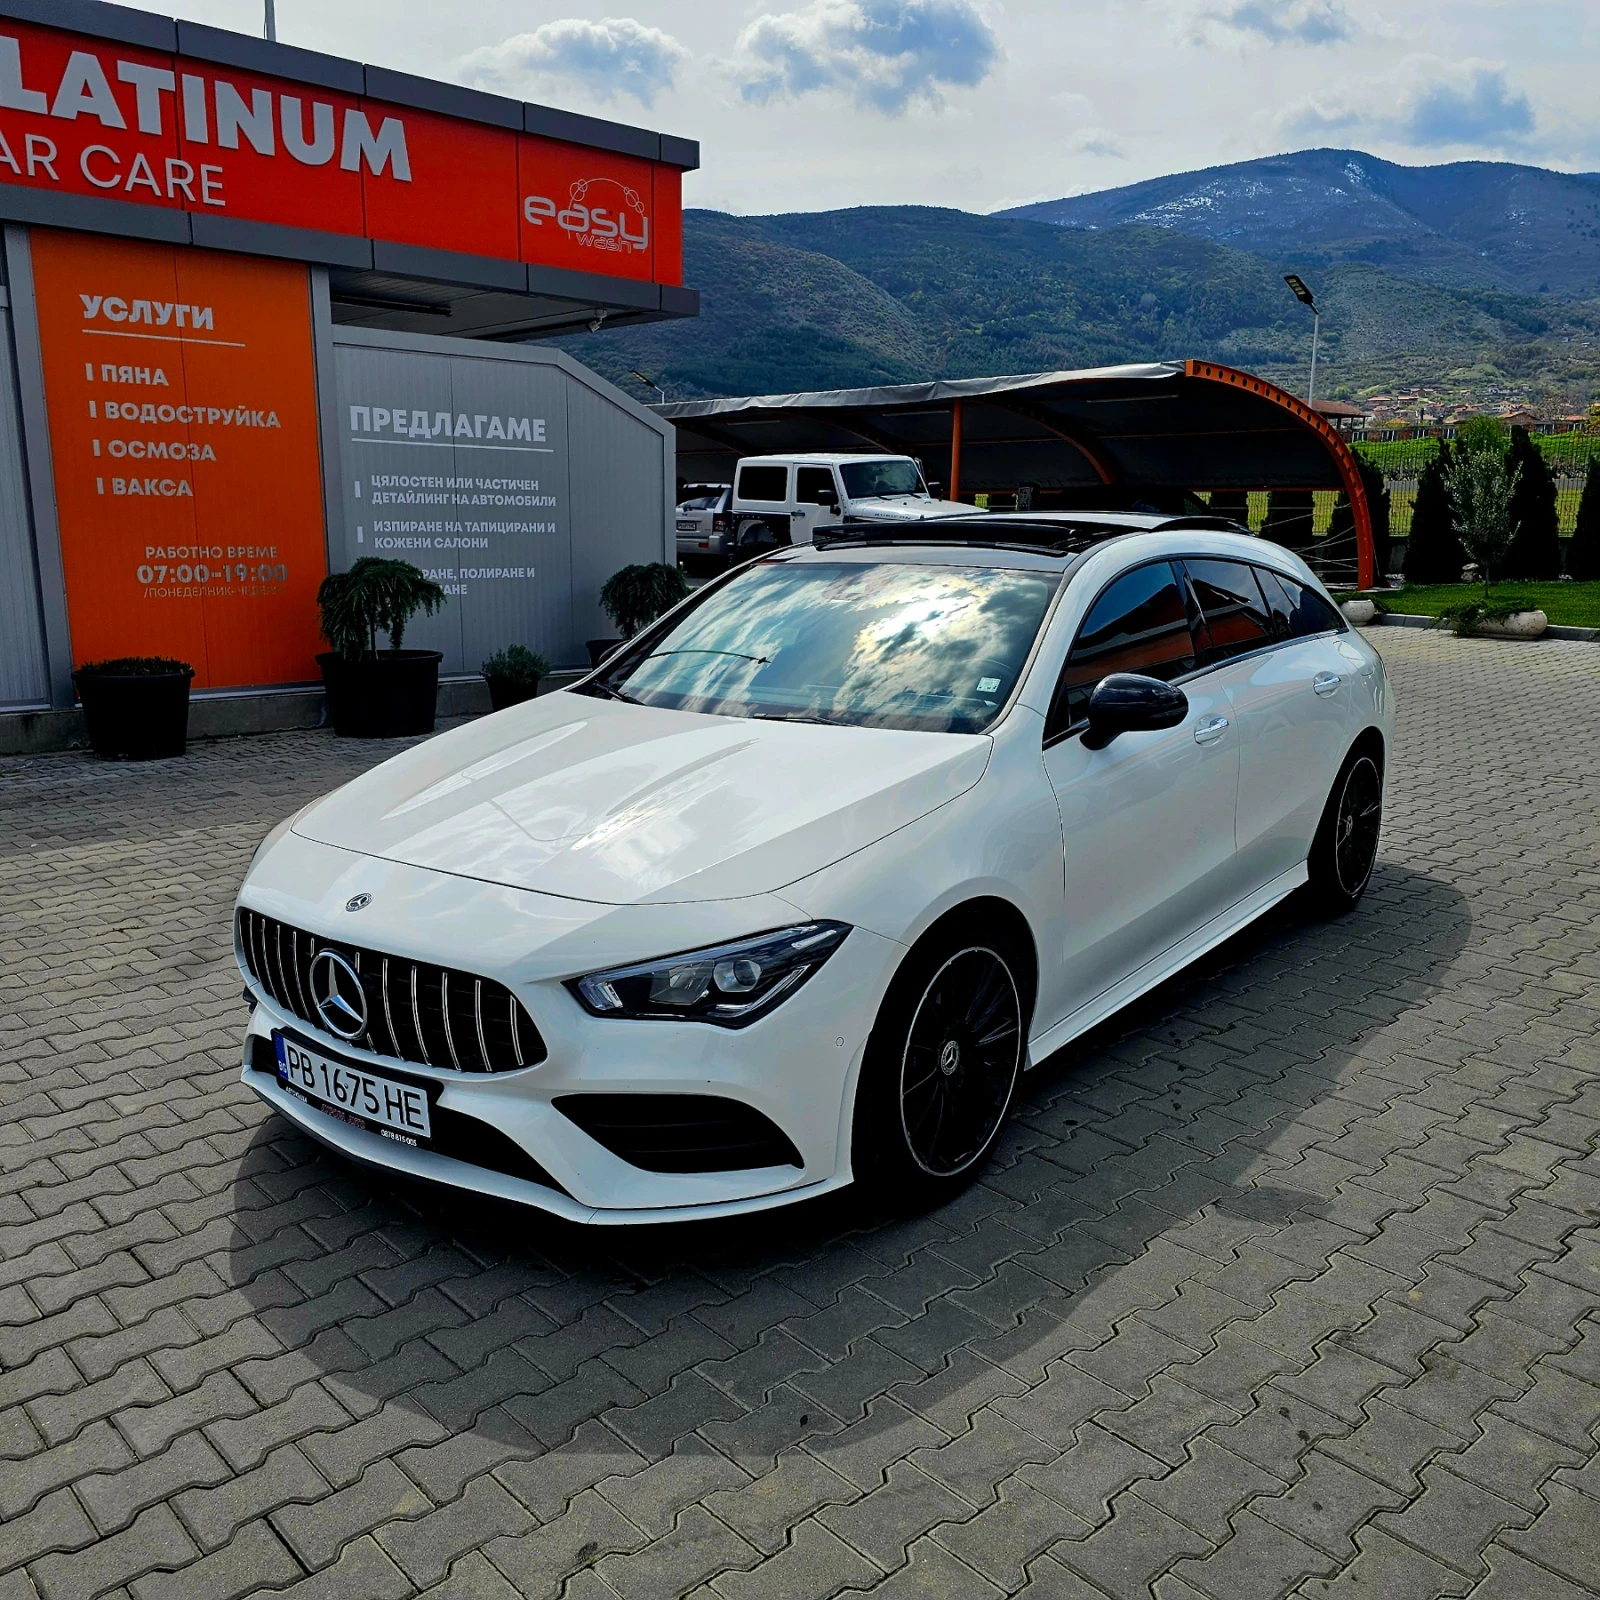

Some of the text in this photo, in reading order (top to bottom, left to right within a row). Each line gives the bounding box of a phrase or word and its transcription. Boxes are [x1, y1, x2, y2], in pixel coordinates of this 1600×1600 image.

[80, 145, 226, 206] CARE
[524, 196, 648, 250] easy
[576, 232, 631, 254] wash
[79, 294, 214, 330] УСЛУГИ
[101, 364, 169, 386] ПЯНА
[105, 401, 281, 428] ВОДОСТРУЙКА
[350, 405, 547, 442] ПРЕДЛАГАМЕ
[108, 440, 216, 461] ОСМОЗА
[112, 478, 193, 497] ВАКСА
[371, 475, 539, 491] ЦЯЛОСТЕН ИЛИ ЧАСТИЧЕН
[372, 490, 556, 507] ДЕТАЙЛИНГ НА АВТОМОБИЛИ
[373, 521, 556, 534] ИЗПИРАНЕ НА ТАПИЦИРАНИ И
[145, 546, 277, 559] РАБОТНО ВРЕМЕ
[374, 538, 489, 549] КОЖЕНИ САЛОНИ
[136, 563, 288, 584] 07:00-19:00
[460, 567, 525, 579] ПОЛИРАНЕ
[527, 567, 536, 578] И
[287, 1046, 425, 1130] PB 1675 HE
